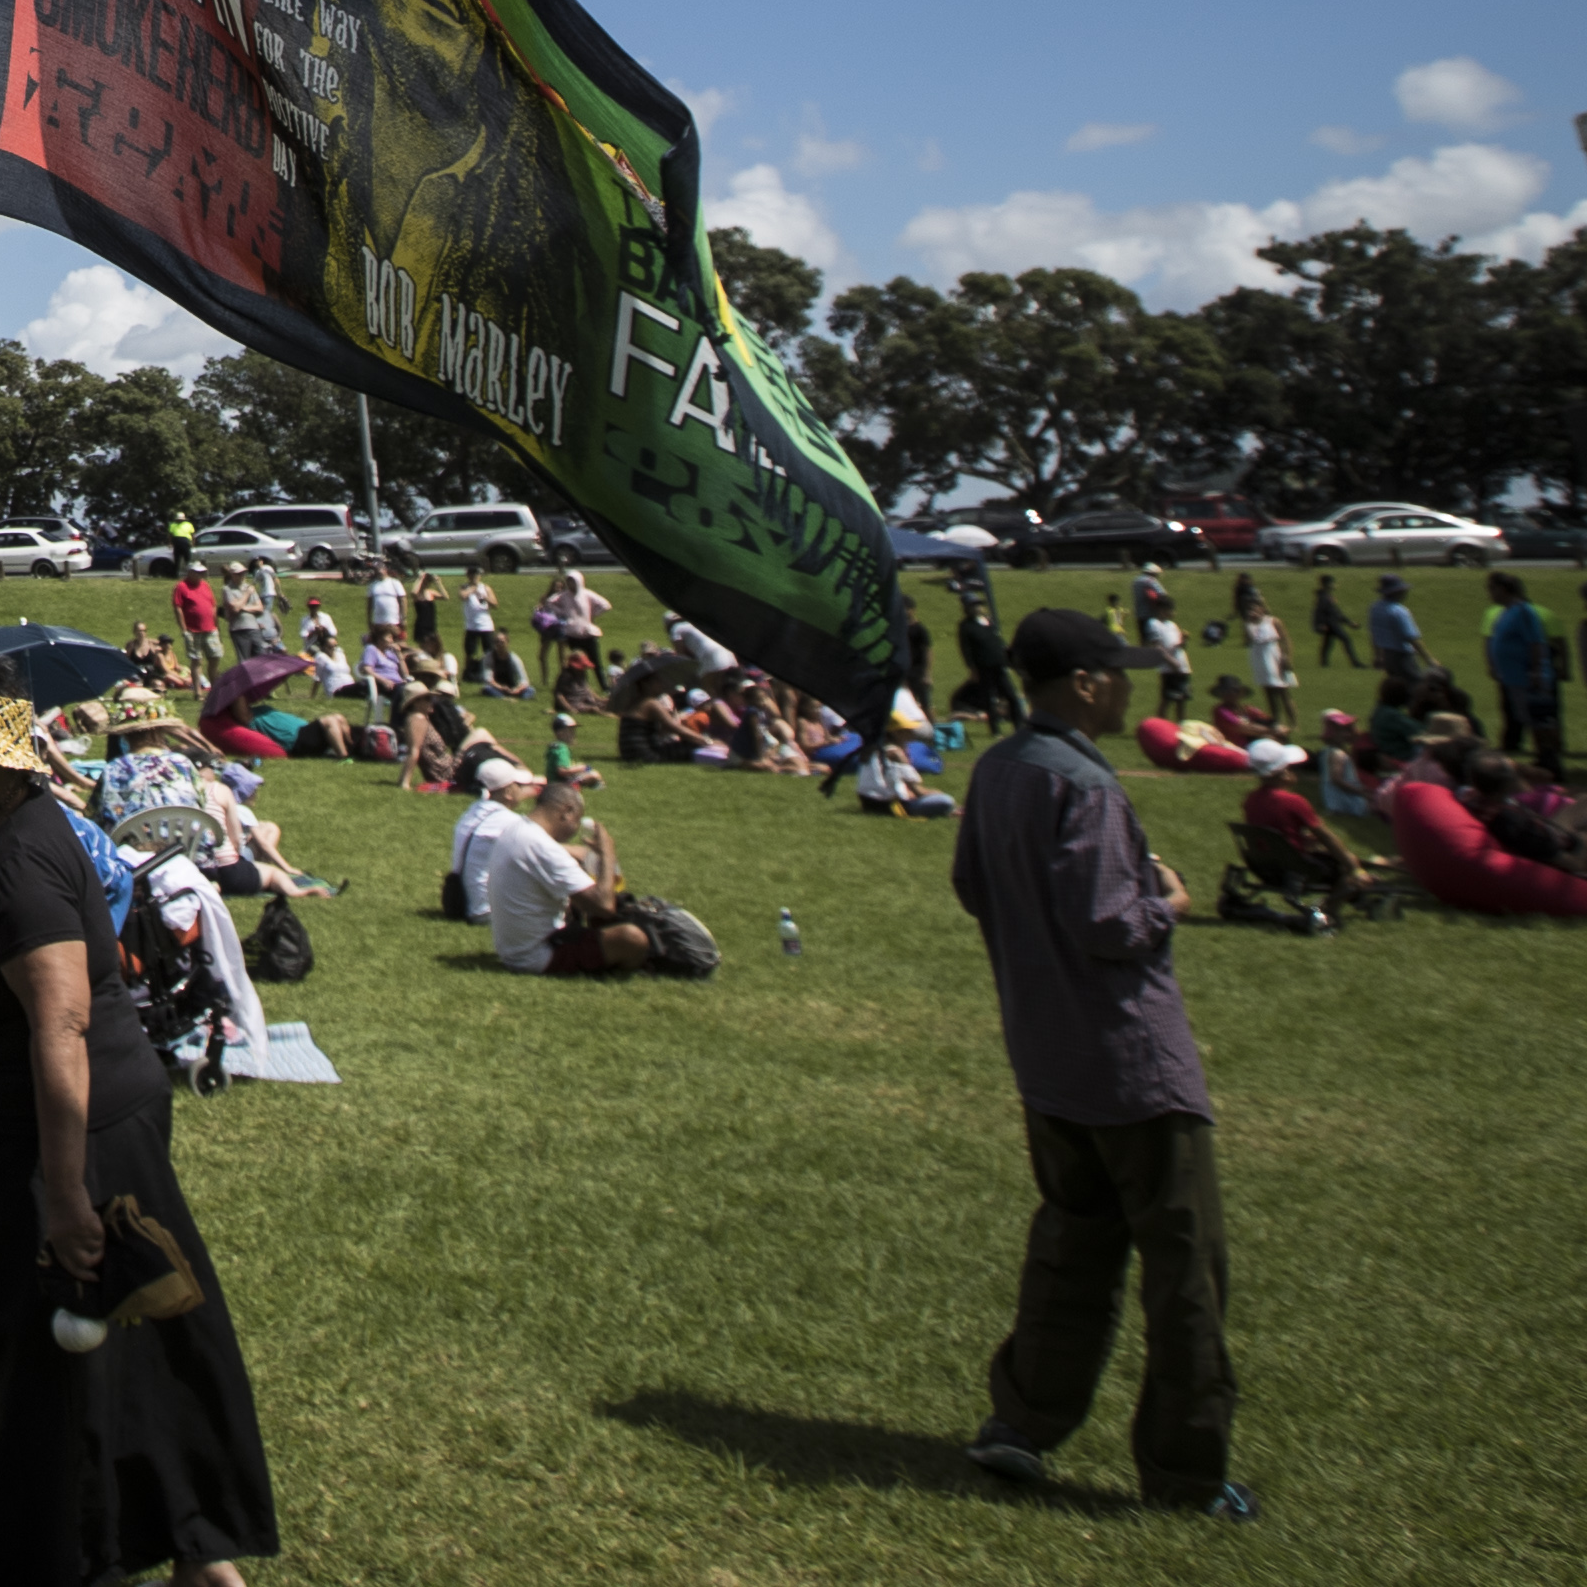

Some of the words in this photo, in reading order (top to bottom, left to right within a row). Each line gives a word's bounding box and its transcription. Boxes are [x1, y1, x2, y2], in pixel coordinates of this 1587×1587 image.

[253, 20, 286, 73] FOR
[272, 132, 297, 188] DAY
[362, 245, 416, 360] BOB
